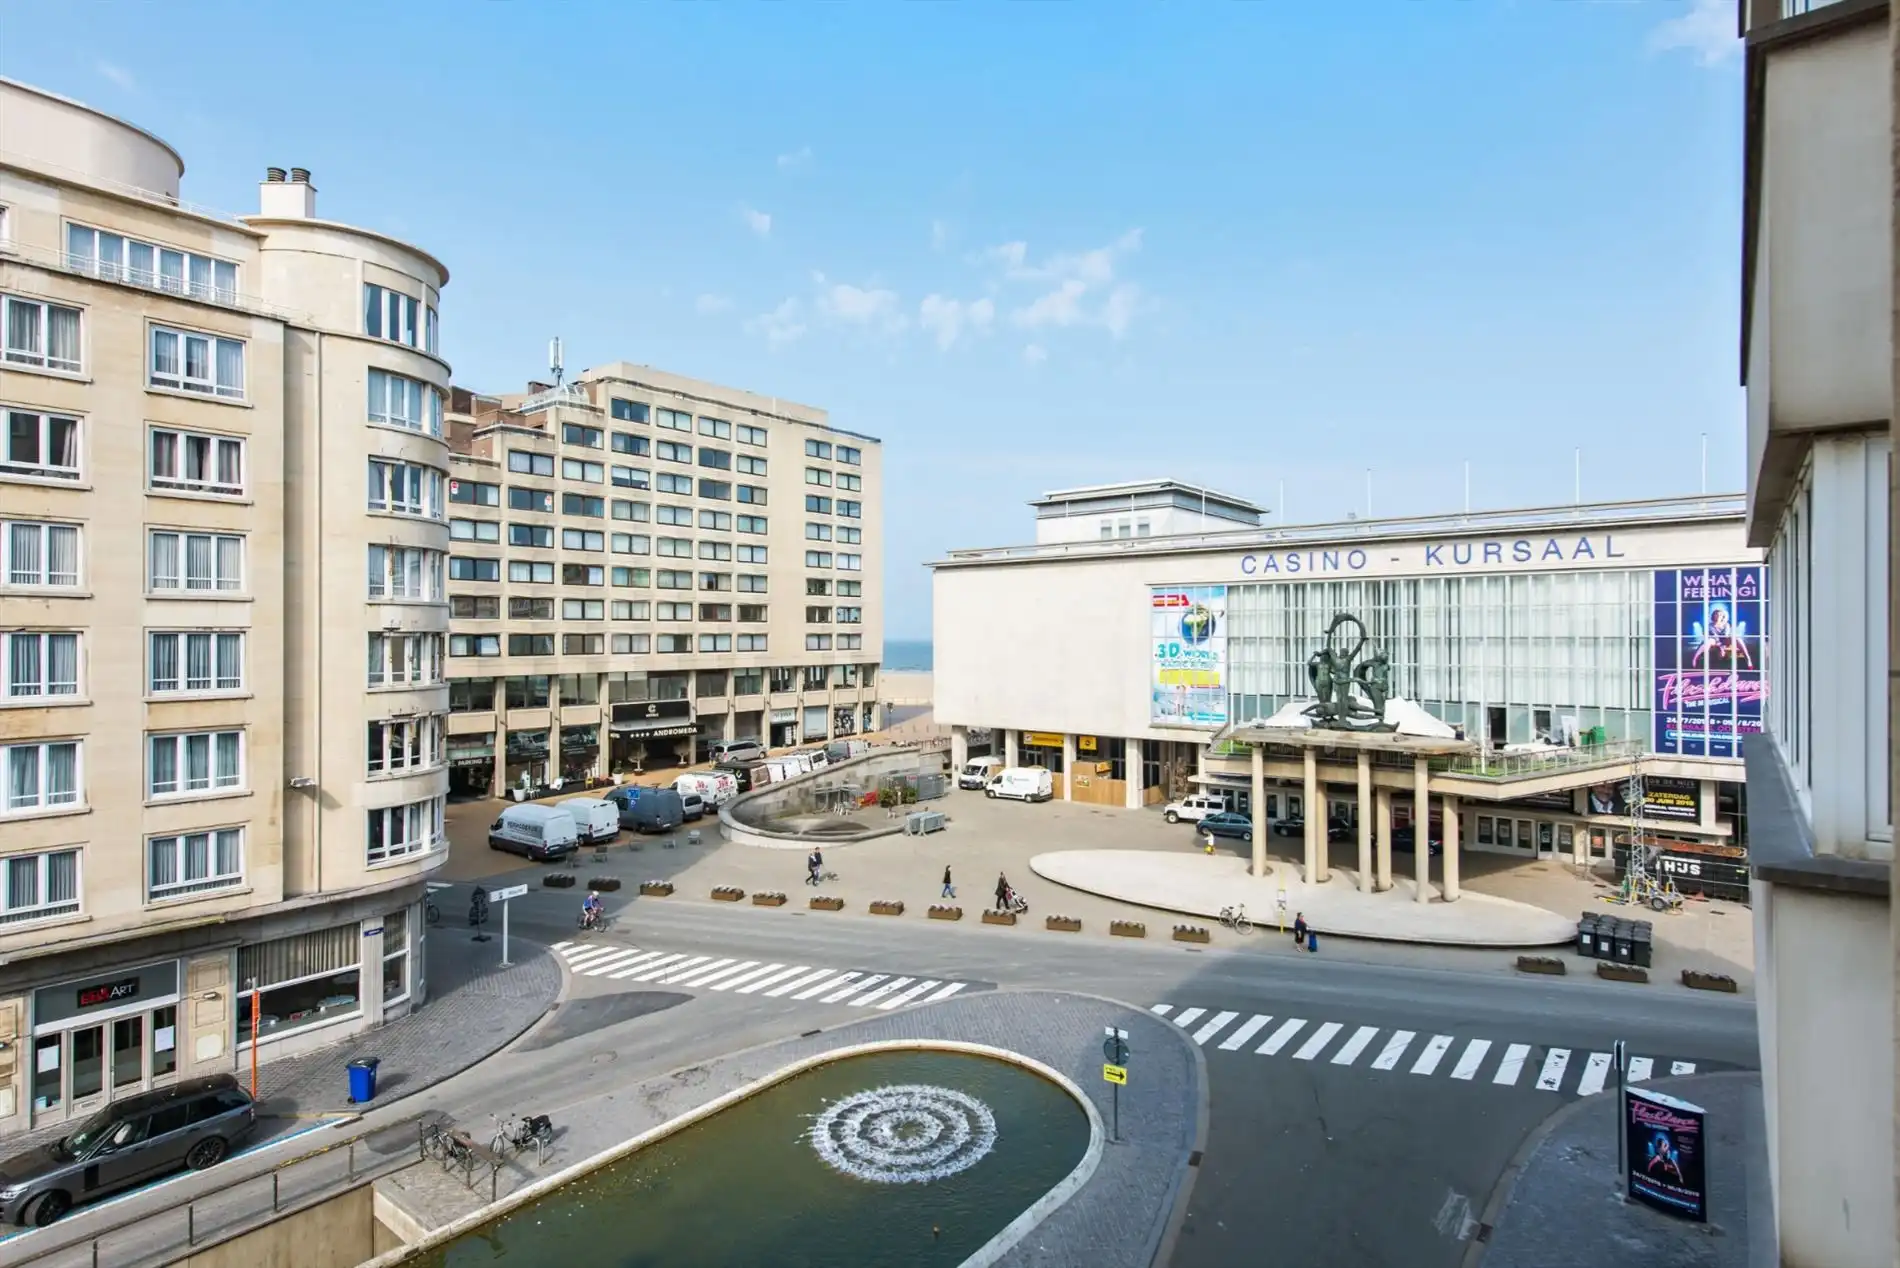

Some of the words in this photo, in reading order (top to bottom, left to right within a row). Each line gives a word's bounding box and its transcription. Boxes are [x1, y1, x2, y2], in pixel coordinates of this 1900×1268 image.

[1241, 549, 1367, 575] CASINO
[1425, 535, 1625, 566] KURSAAL
[1743, 573, 1756, 585] A
[653, 727, 698, 737] ANDROMEDA
[1647, 791, 1690, 800] ZATERDAG
[110, 984, 135, 998] ART
